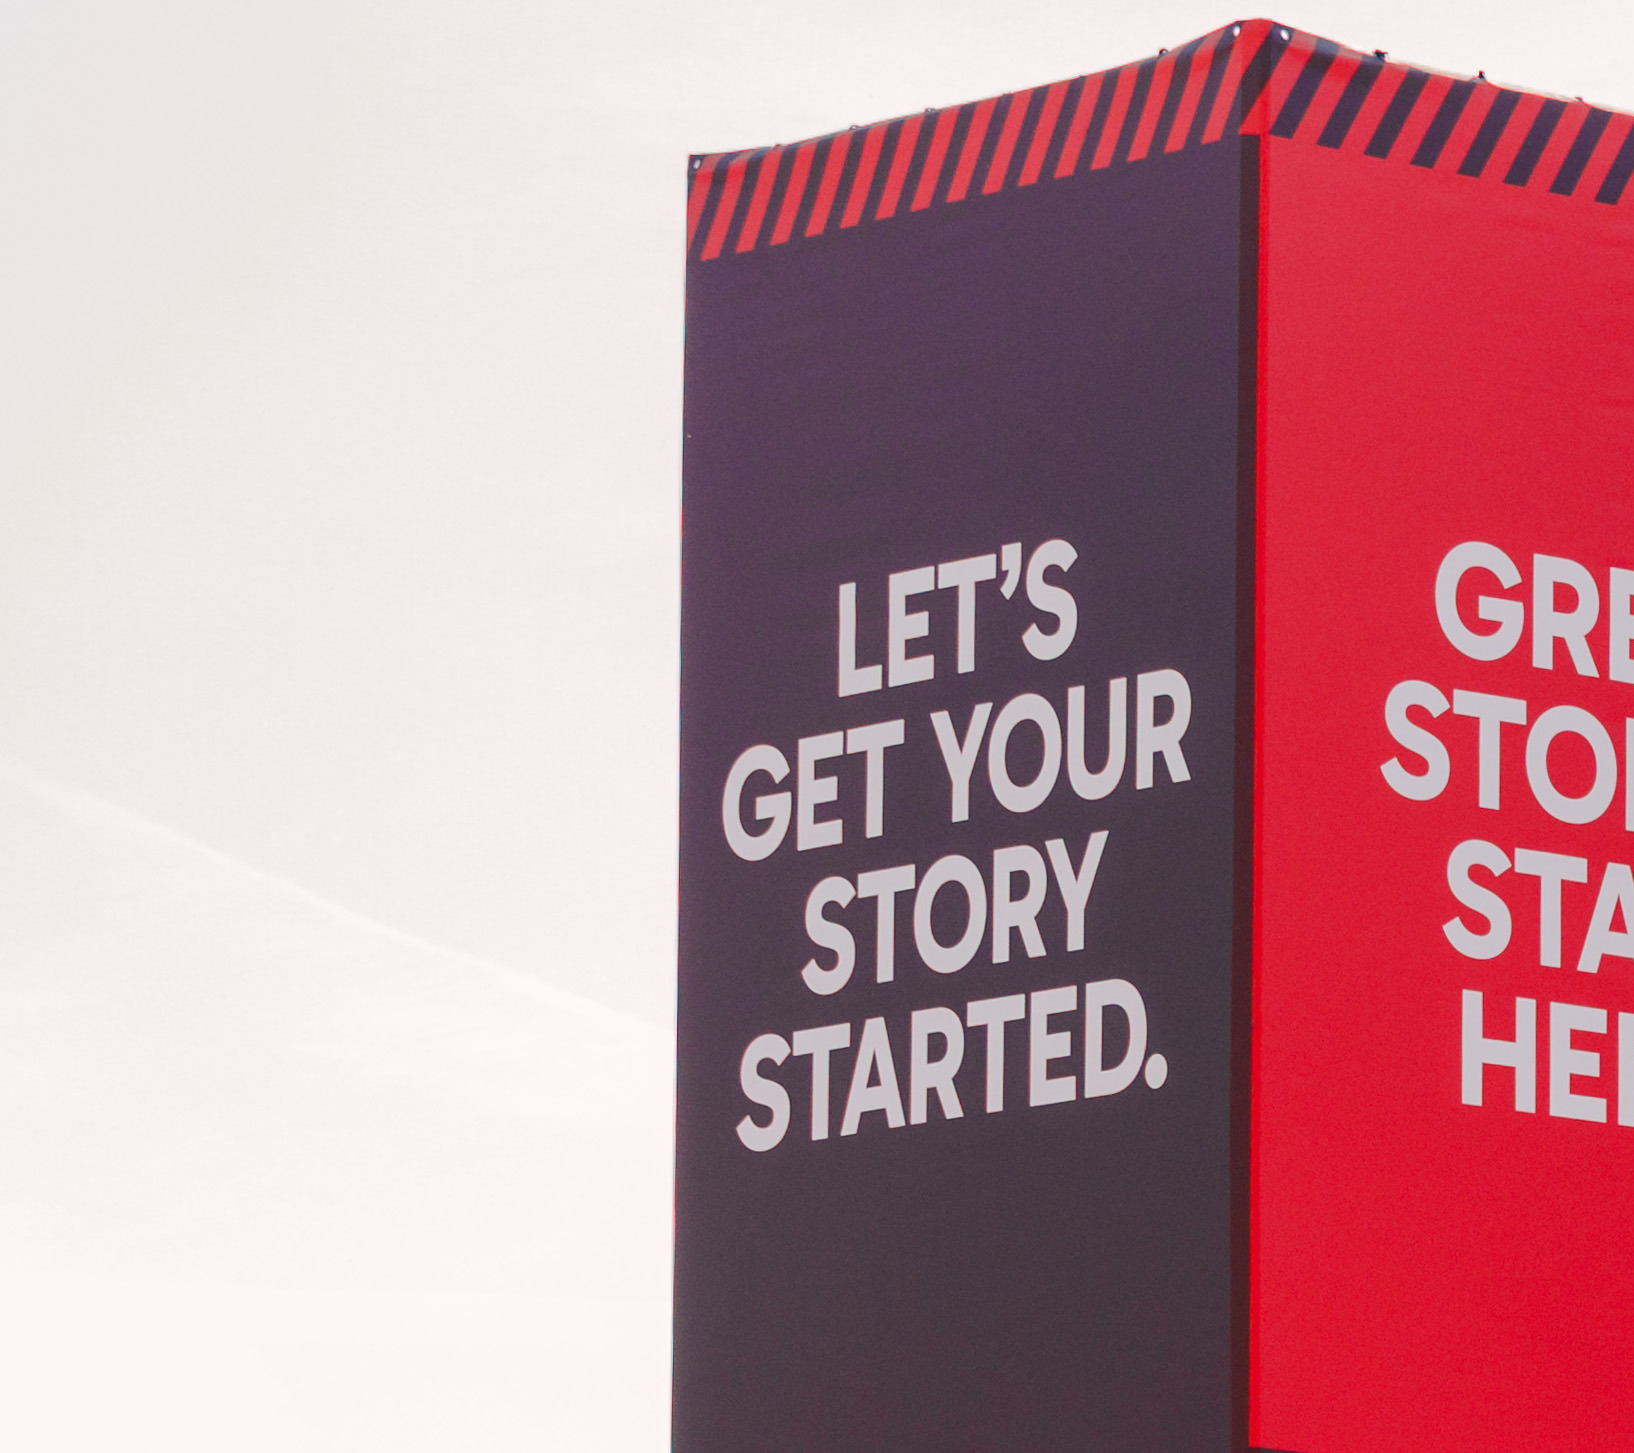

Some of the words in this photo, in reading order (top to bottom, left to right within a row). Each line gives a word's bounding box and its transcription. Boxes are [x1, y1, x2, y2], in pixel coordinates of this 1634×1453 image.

[837, 539, 1078, 698] LET'S
[722, 720, 903, 862] GET
[931, 669, 1192, 823] YOUR
[801, 831, 1109, 996] STORY
[735, 978, 1169, 1153] STARTED.
